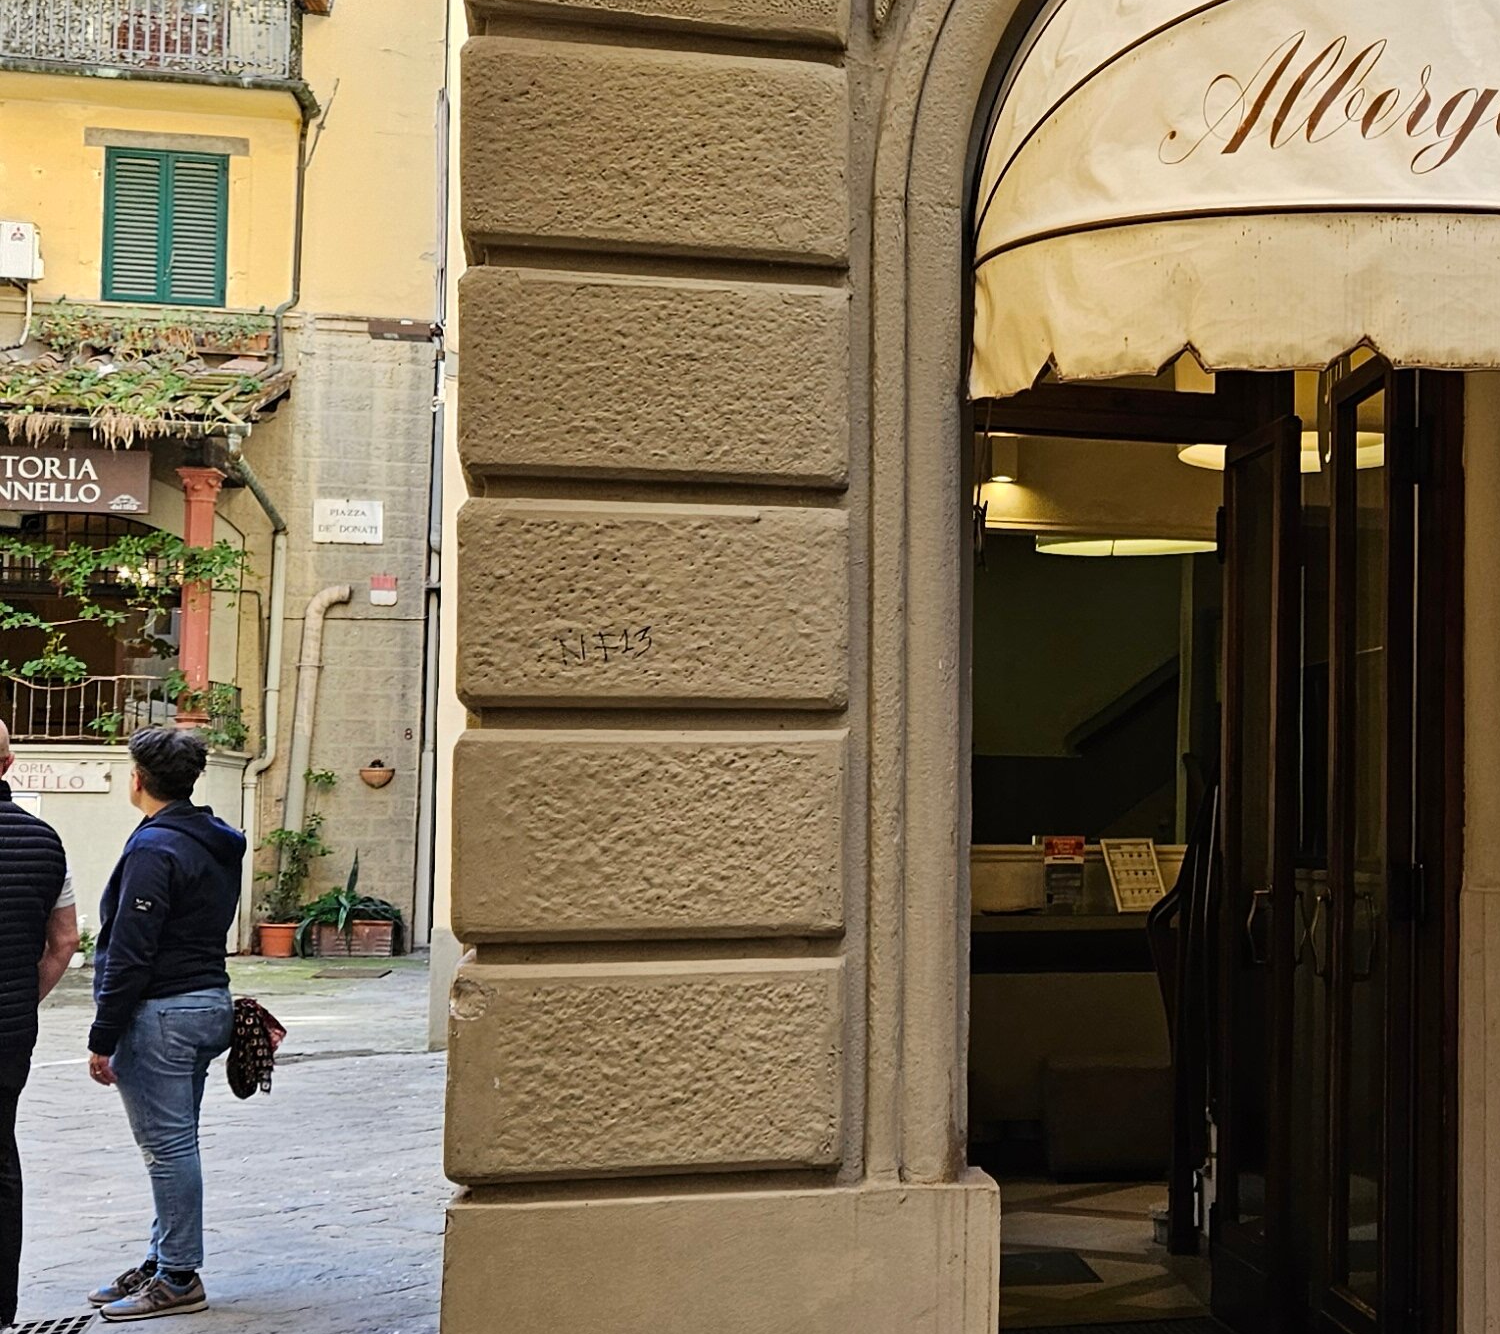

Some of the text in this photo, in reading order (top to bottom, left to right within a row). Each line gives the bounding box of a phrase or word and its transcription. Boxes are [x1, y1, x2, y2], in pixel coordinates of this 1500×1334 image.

[0, 455, 99, 481] TORIA
[329, 508, 367, 517] PIAZZA
[339, 525, 378, 535] DONATI
[404, 727, 413, 740] 8
